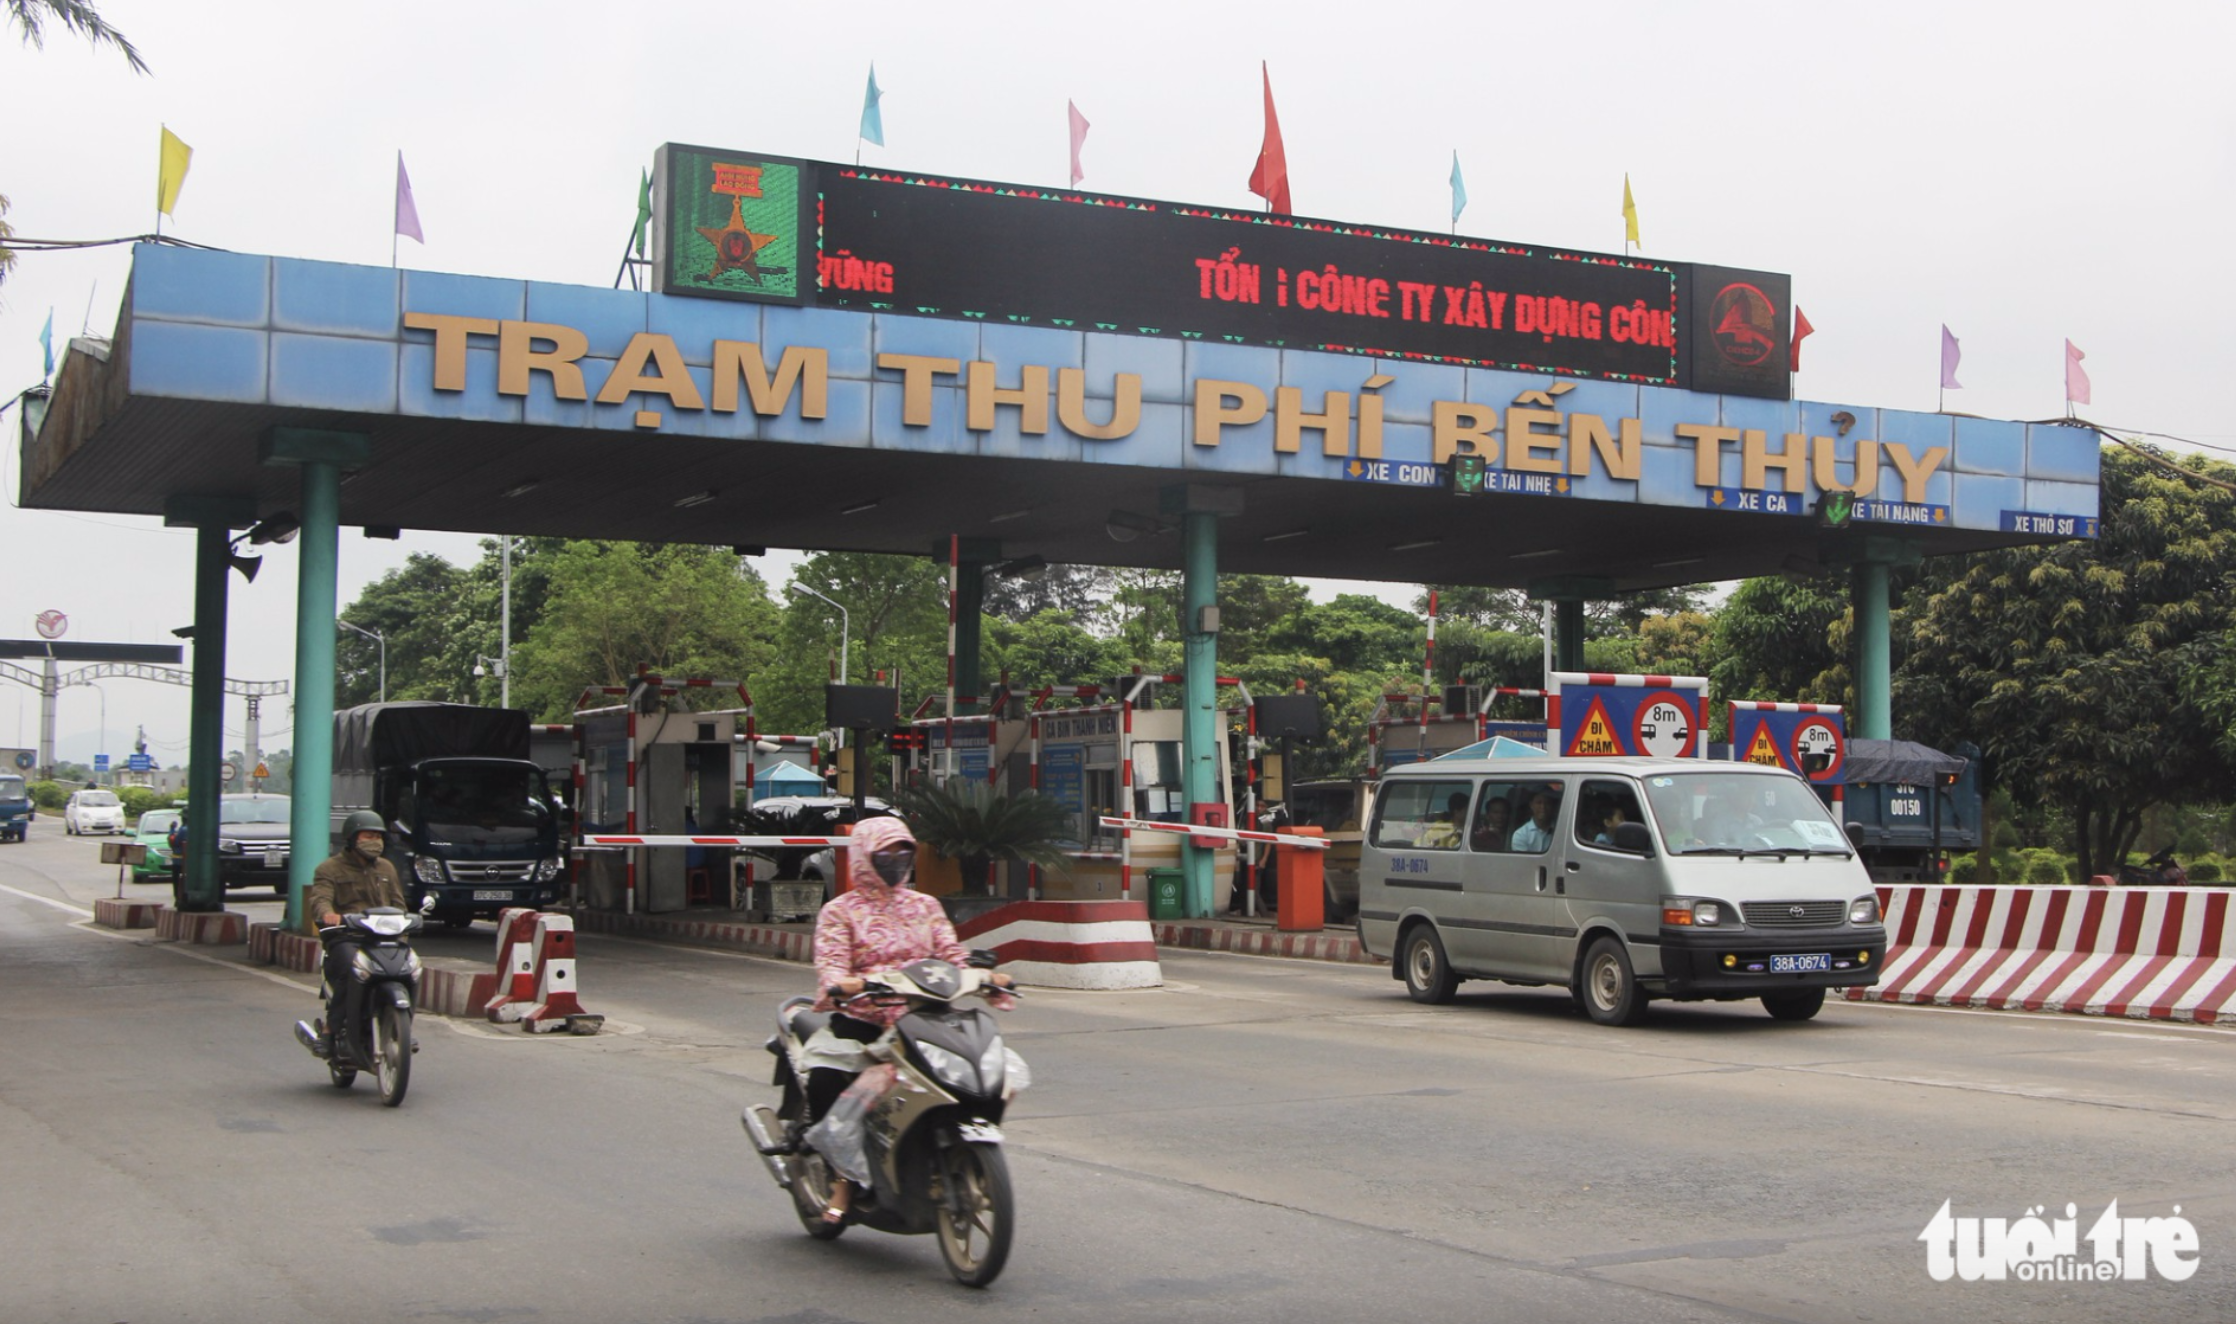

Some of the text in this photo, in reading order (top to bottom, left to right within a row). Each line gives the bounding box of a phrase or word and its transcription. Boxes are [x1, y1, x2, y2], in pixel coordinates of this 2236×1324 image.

[1397, 281, 1437, 322] TY
[1444, 281, 1507, 330] XÂY
[1515, 294, 1602, 342] DỰNG
[404, 312, 1950, 503] TRẠM THU PHÍ BẾN THỦY
[1366, 462, 1436, 484] XE CON
[1526, 474, 1552, 496] NHẸ
[1738, 491, 1788, 512] XE CA
[2014, 512, 2075, 536] XE THÔ SƠ
[1653, 706, 1676, 721] 8m
[1591, 721, 1602, 735] ĐI
[1809, 728, 1829, 741] 8m
[1891, 799, 1921, 815] 00150
[1774, 956, 1827, 971] 38A-0674
